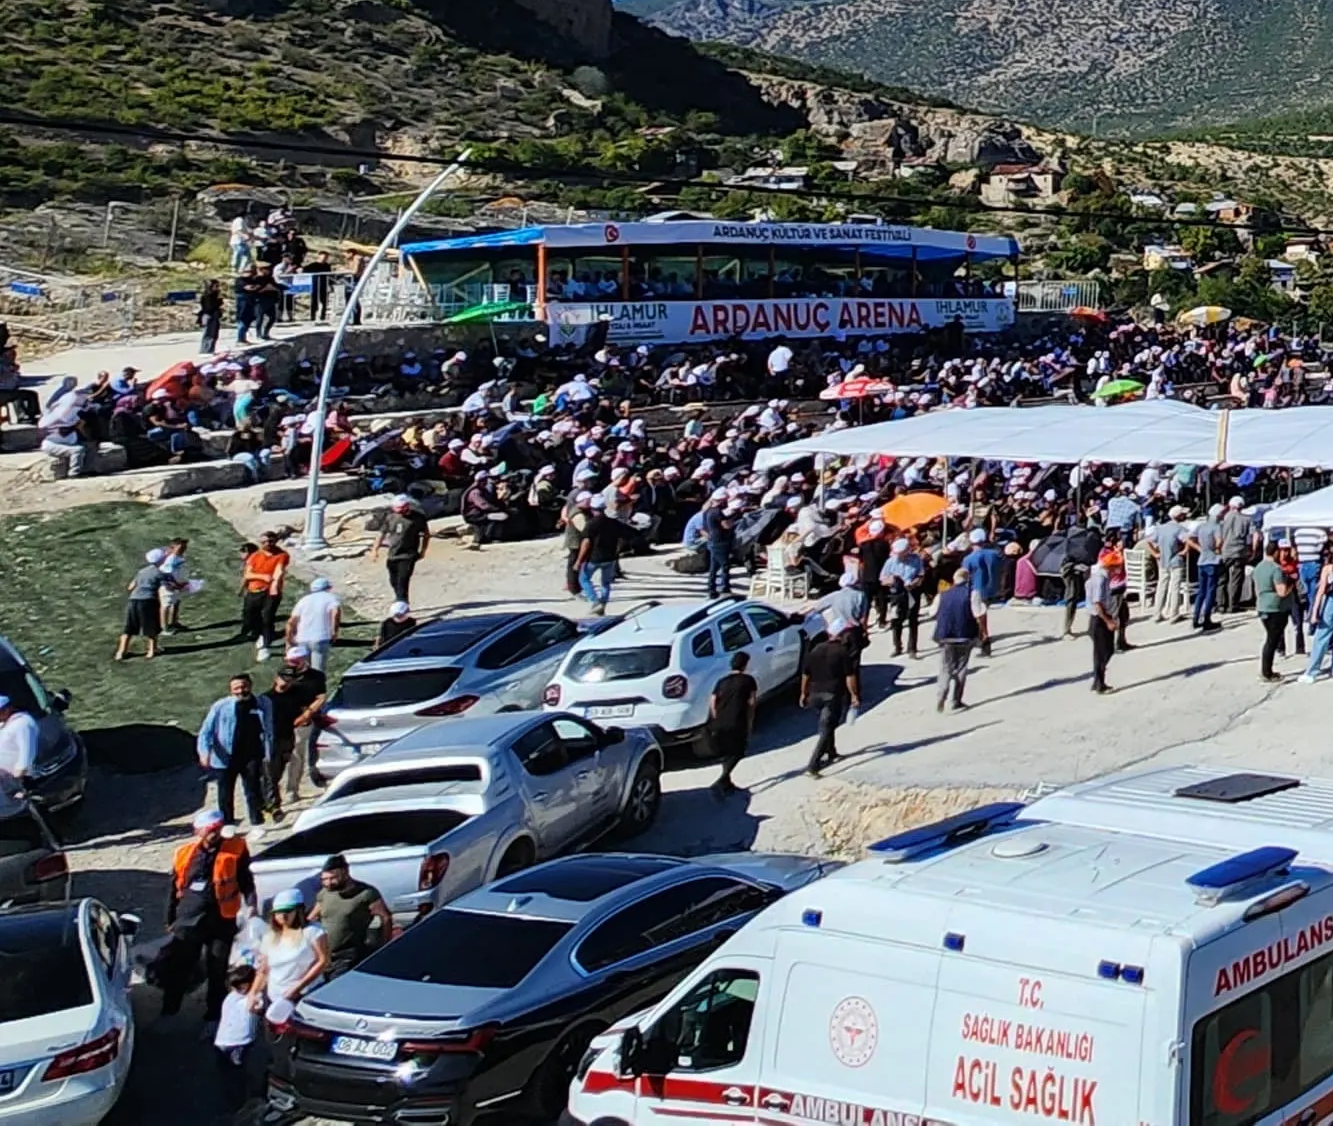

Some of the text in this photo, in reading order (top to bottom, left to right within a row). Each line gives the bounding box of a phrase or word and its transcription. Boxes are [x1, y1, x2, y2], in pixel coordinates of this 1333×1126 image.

[713, 225, 768, 241] ARDANUÇ
[771, 226, 810, 240] KÜLTÜR
[813, 227, 828, 240] VE
[829, 227, 863, 240] SANAT
[688, 300, 922, 335] ARDANUÇ ARENA
[961, 1013, 1095, 1063] SAĞLIK BAKANLIĞI
[952, 1055, 1098, 1126] ACİL SAĞLIK
